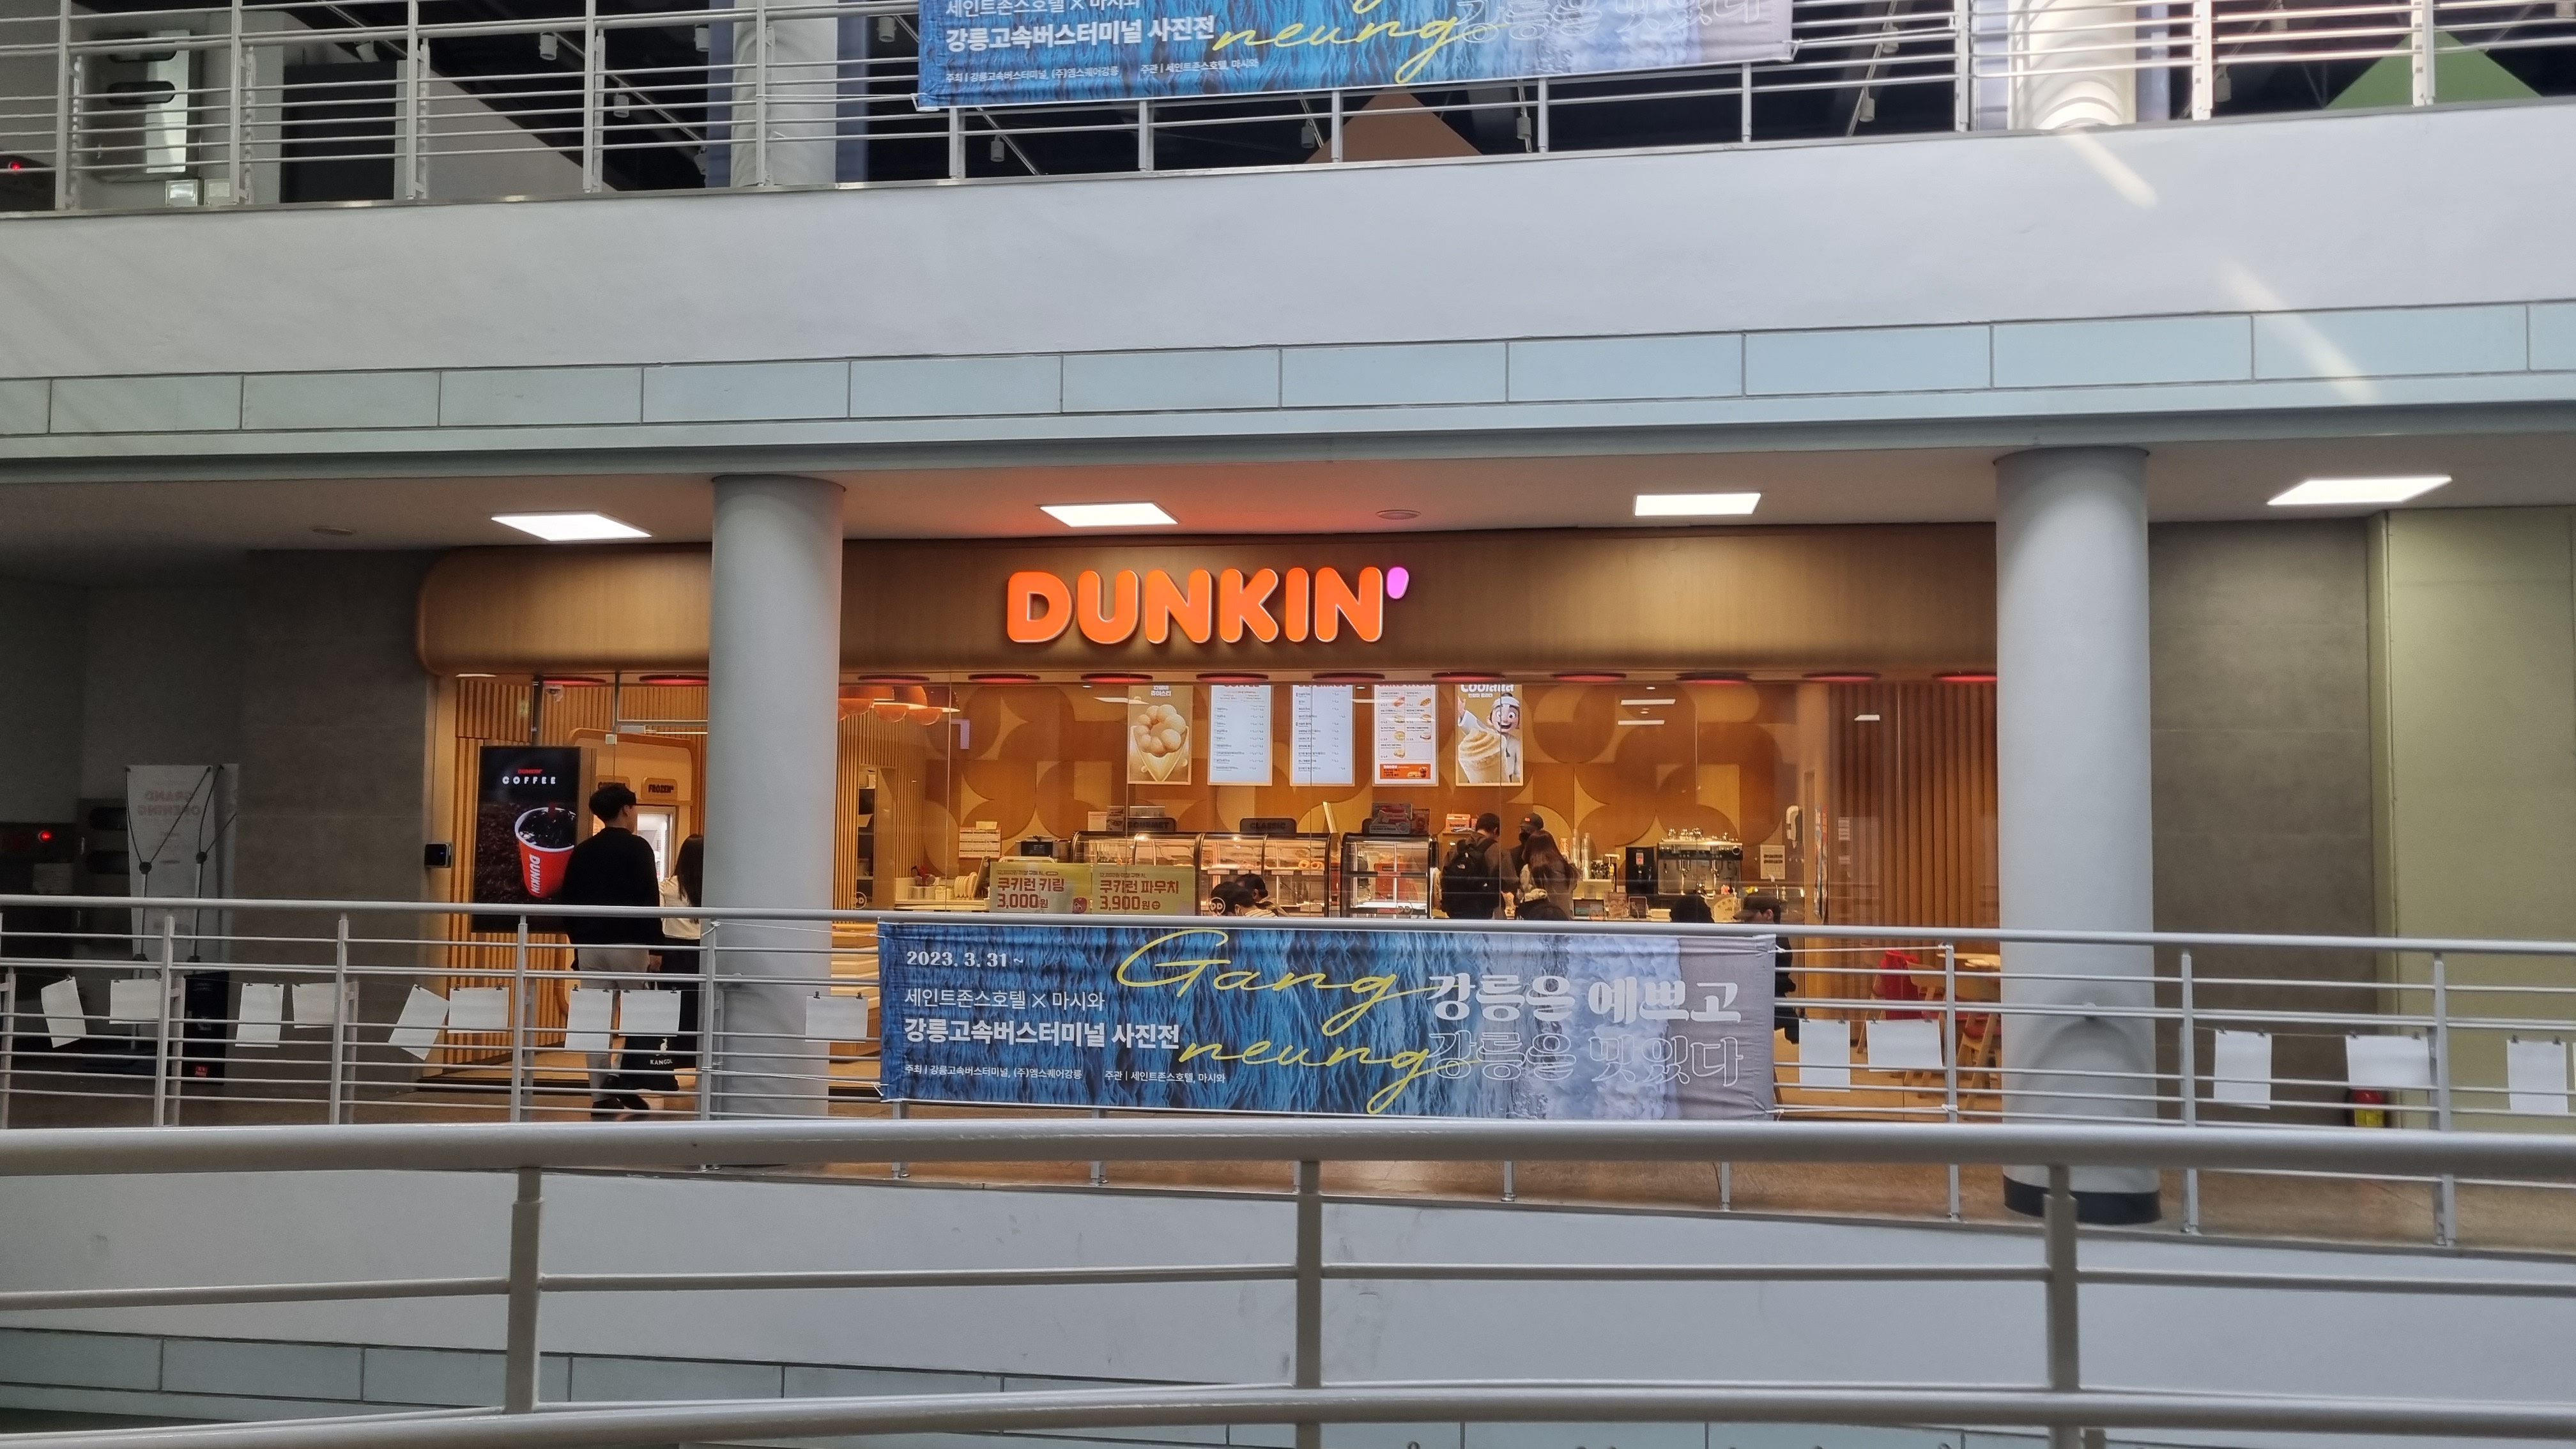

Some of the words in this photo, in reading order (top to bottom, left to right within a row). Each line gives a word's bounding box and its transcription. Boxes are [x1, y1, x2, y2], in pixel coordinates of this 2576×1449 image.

[946, 18, 1142, 52] 강릉고속버스터미널
[1147, 14, 1215, 42] 사진전
[1213, 17, 1509, 84] neung
[1140, 64, 1158, 73] 주관
[1008, 566, 1409, 644] DUNKIN'
[502, 776, 556, 785] COFFEE
[997, 877, 1036, 891] 쿠키런
[1039, 878, 1064, 892] 키링
[1100, 880, 1137, 893] 쿠키런
[907, 951, 958, 967] 2023.
[964, 952, 981, 967] 3.
[986, 953, 1007, 967] 31
[1116, 929, 1459, 1036] Gang
[905, 988, 1025, 1009] 세인트존스호텔
[1052, 991, 1105, 1011] 마시와
[1588, 976, 1742, 1023] 예쁘고
[904, 1018, 1105, 1048] 강릉고속버스터미널
[1112, 1023, 1179, 1050] 사진전
[905, 1064, 922, 1075] 주최
[930, 1065, 1011, 1078] 강릉고속버스터미널,
[1013, 1068, 1082, 1080] (주)엠스퀘어강릉
[1105, 1070, 1123, 1080] 주관
[1130, 1071, 1196, 1084] 세인트존스호텔,
[1198, 1073, 1226, 1084] 마시와
[1179, 1039, 1480, 1115] neung
